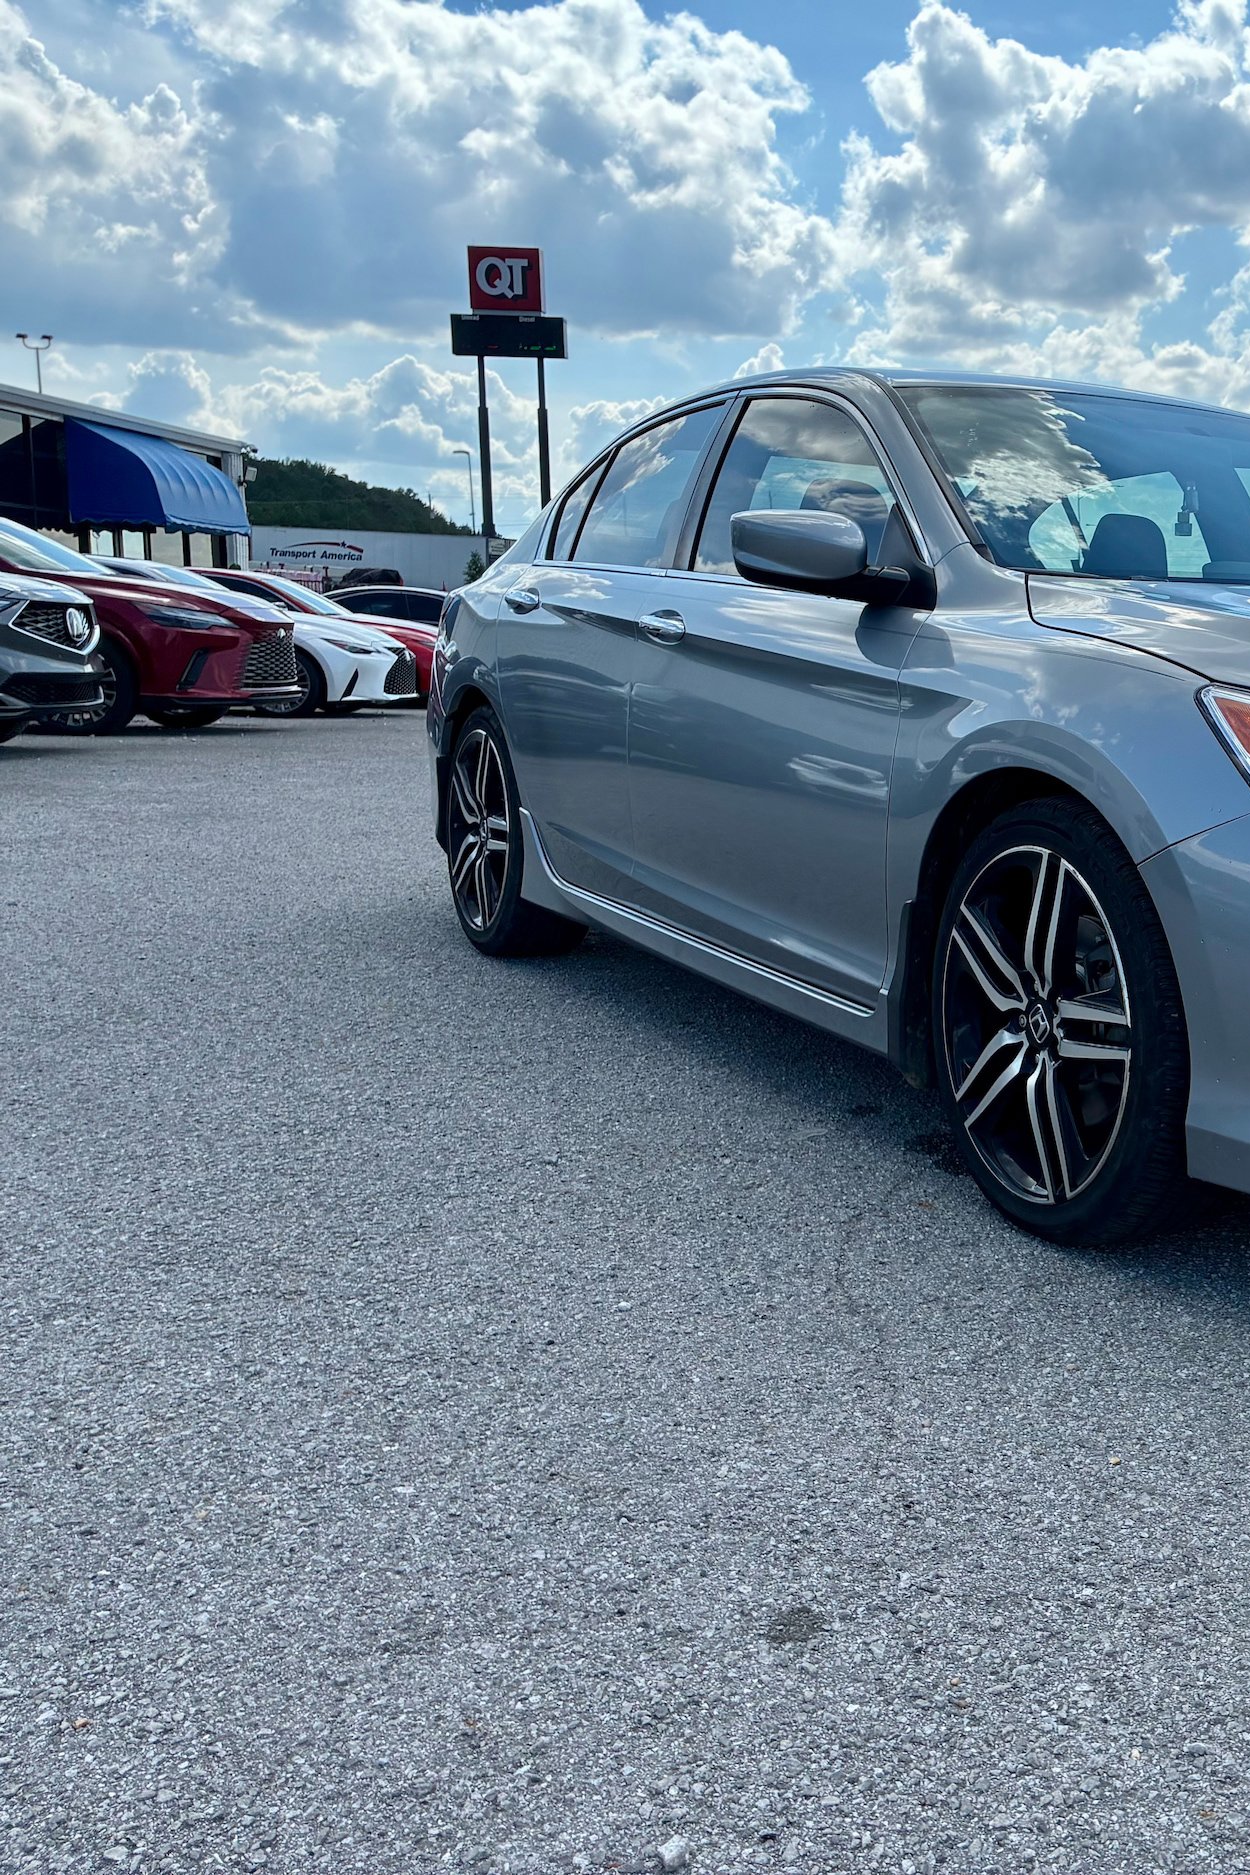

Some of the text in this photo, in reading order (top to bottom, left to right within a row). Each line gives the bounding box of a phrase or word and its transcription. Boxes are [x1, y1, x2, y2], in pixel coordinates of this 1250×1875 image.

[476, 256, 528, 299] QT
[270, 547, 363, 561] Transport America
